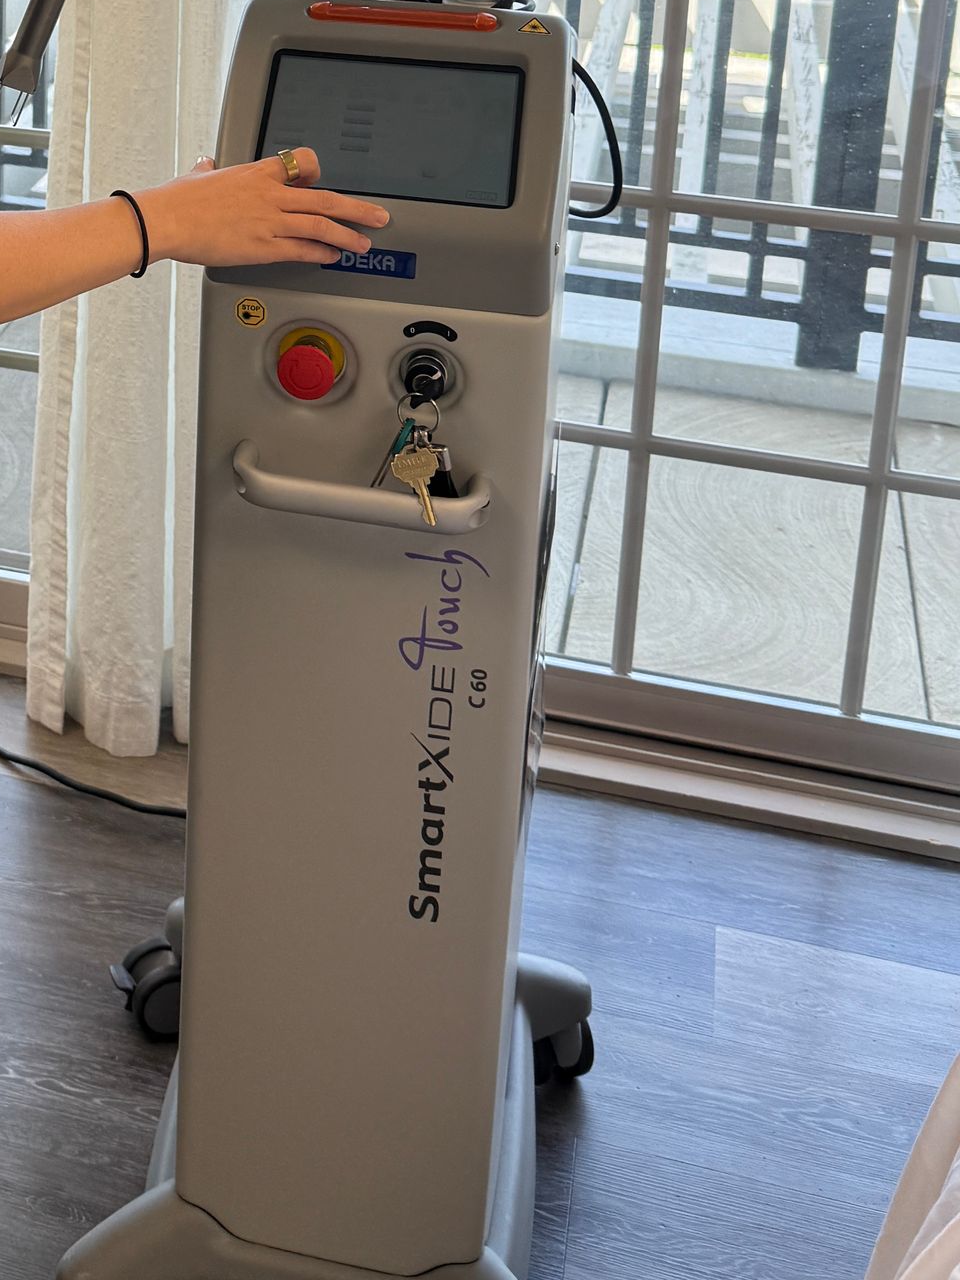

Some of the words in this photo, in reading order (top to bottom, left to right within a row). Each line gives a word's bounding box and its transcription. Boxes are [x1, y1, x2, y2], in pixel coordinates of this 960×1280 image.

[340, 250, 396, 272] DEKA
[241, 303, 261, 312] STOP
[398, 548, 490, 671] Touch
[408, 664, 457, 923] SmartXIDE
